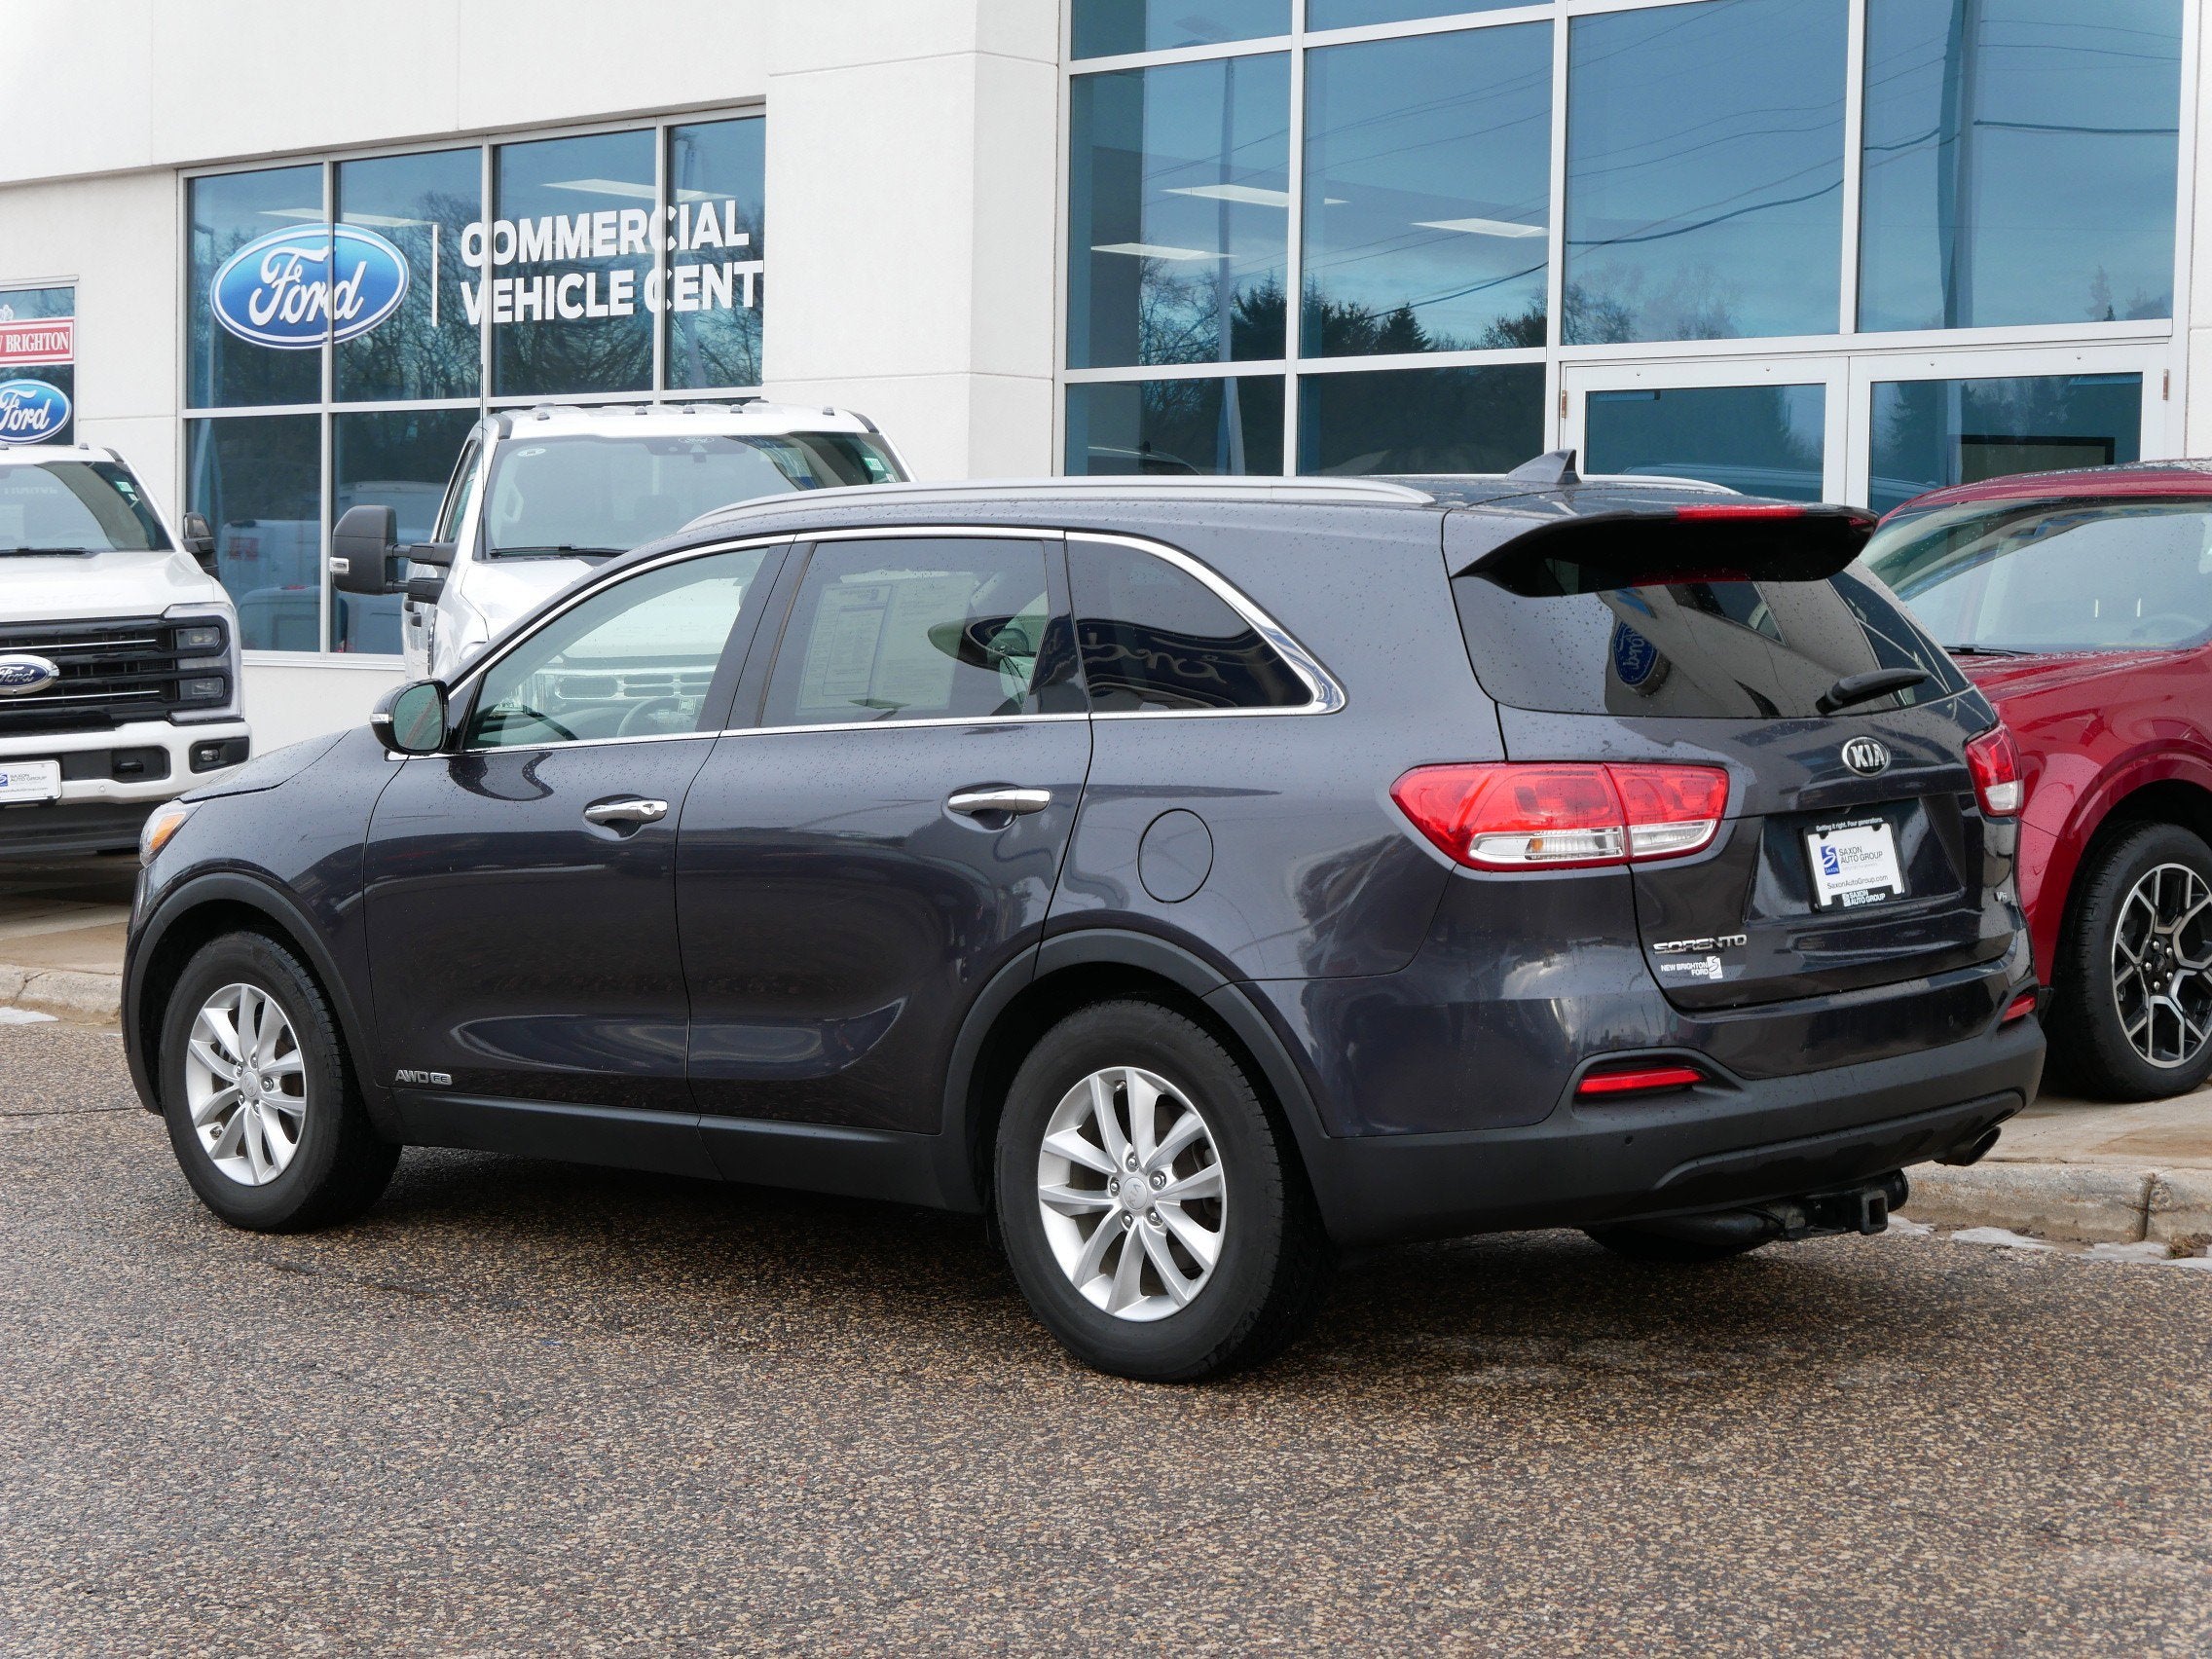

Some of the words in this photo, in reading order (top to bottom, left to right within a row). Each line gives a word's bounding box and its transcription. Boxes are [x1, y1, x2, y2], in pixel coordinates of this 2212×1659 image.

[461, 201, 750, 268] COMMERCIAL
[248, 245, 368, 327] Ford
[461, 273, 634, 325] VEHICLE
[6, 332, 69, 352] BRIGHTON
[0, 389, 52, 431] Ford
[1851, 744, 1885, 768] KIA
[1839, 846, 1862, 856] SAXON
[1840, 854, 1859, 865] AUTO
[1860, 851, 1883, 862] GROUP
[1826, 875, 1888, 889] SaxonAutoGroup.com
[1653, 935, 1748, 955] SORENTO
[1677, 961, 1709, 971] BRIGHTON
[395, 1070, 428, 1084] AWD
